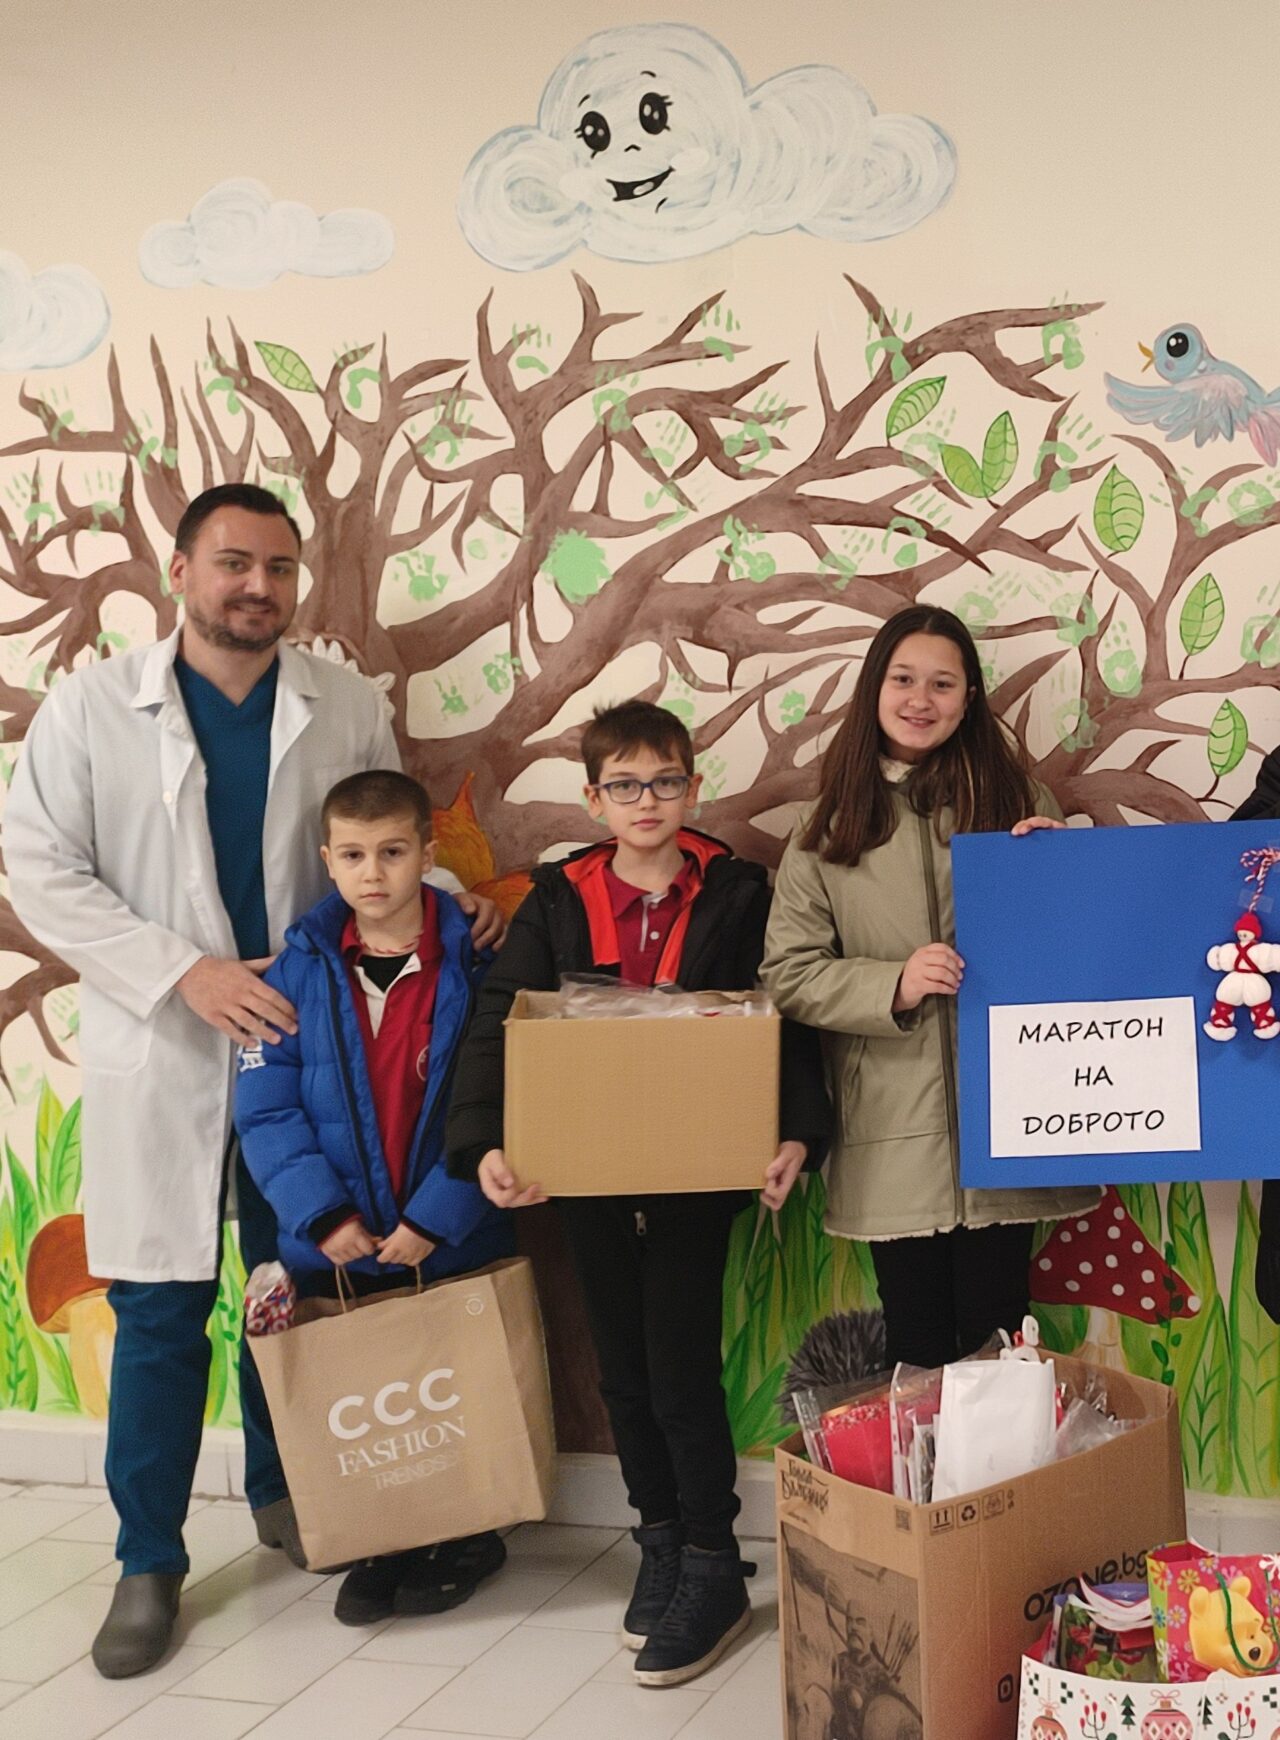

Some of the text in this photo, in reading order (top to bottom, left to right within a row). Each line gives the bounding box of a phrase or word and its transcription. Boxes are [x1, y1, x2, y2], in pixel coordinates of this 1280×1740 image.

[1018, 1017, 1164, 1044] МАРАТОН
[1074, 1065, 1114, 1087] НА
[328, 1368, 461, 1440] CCC
[336, 1415, 466, 1477] FASHION
